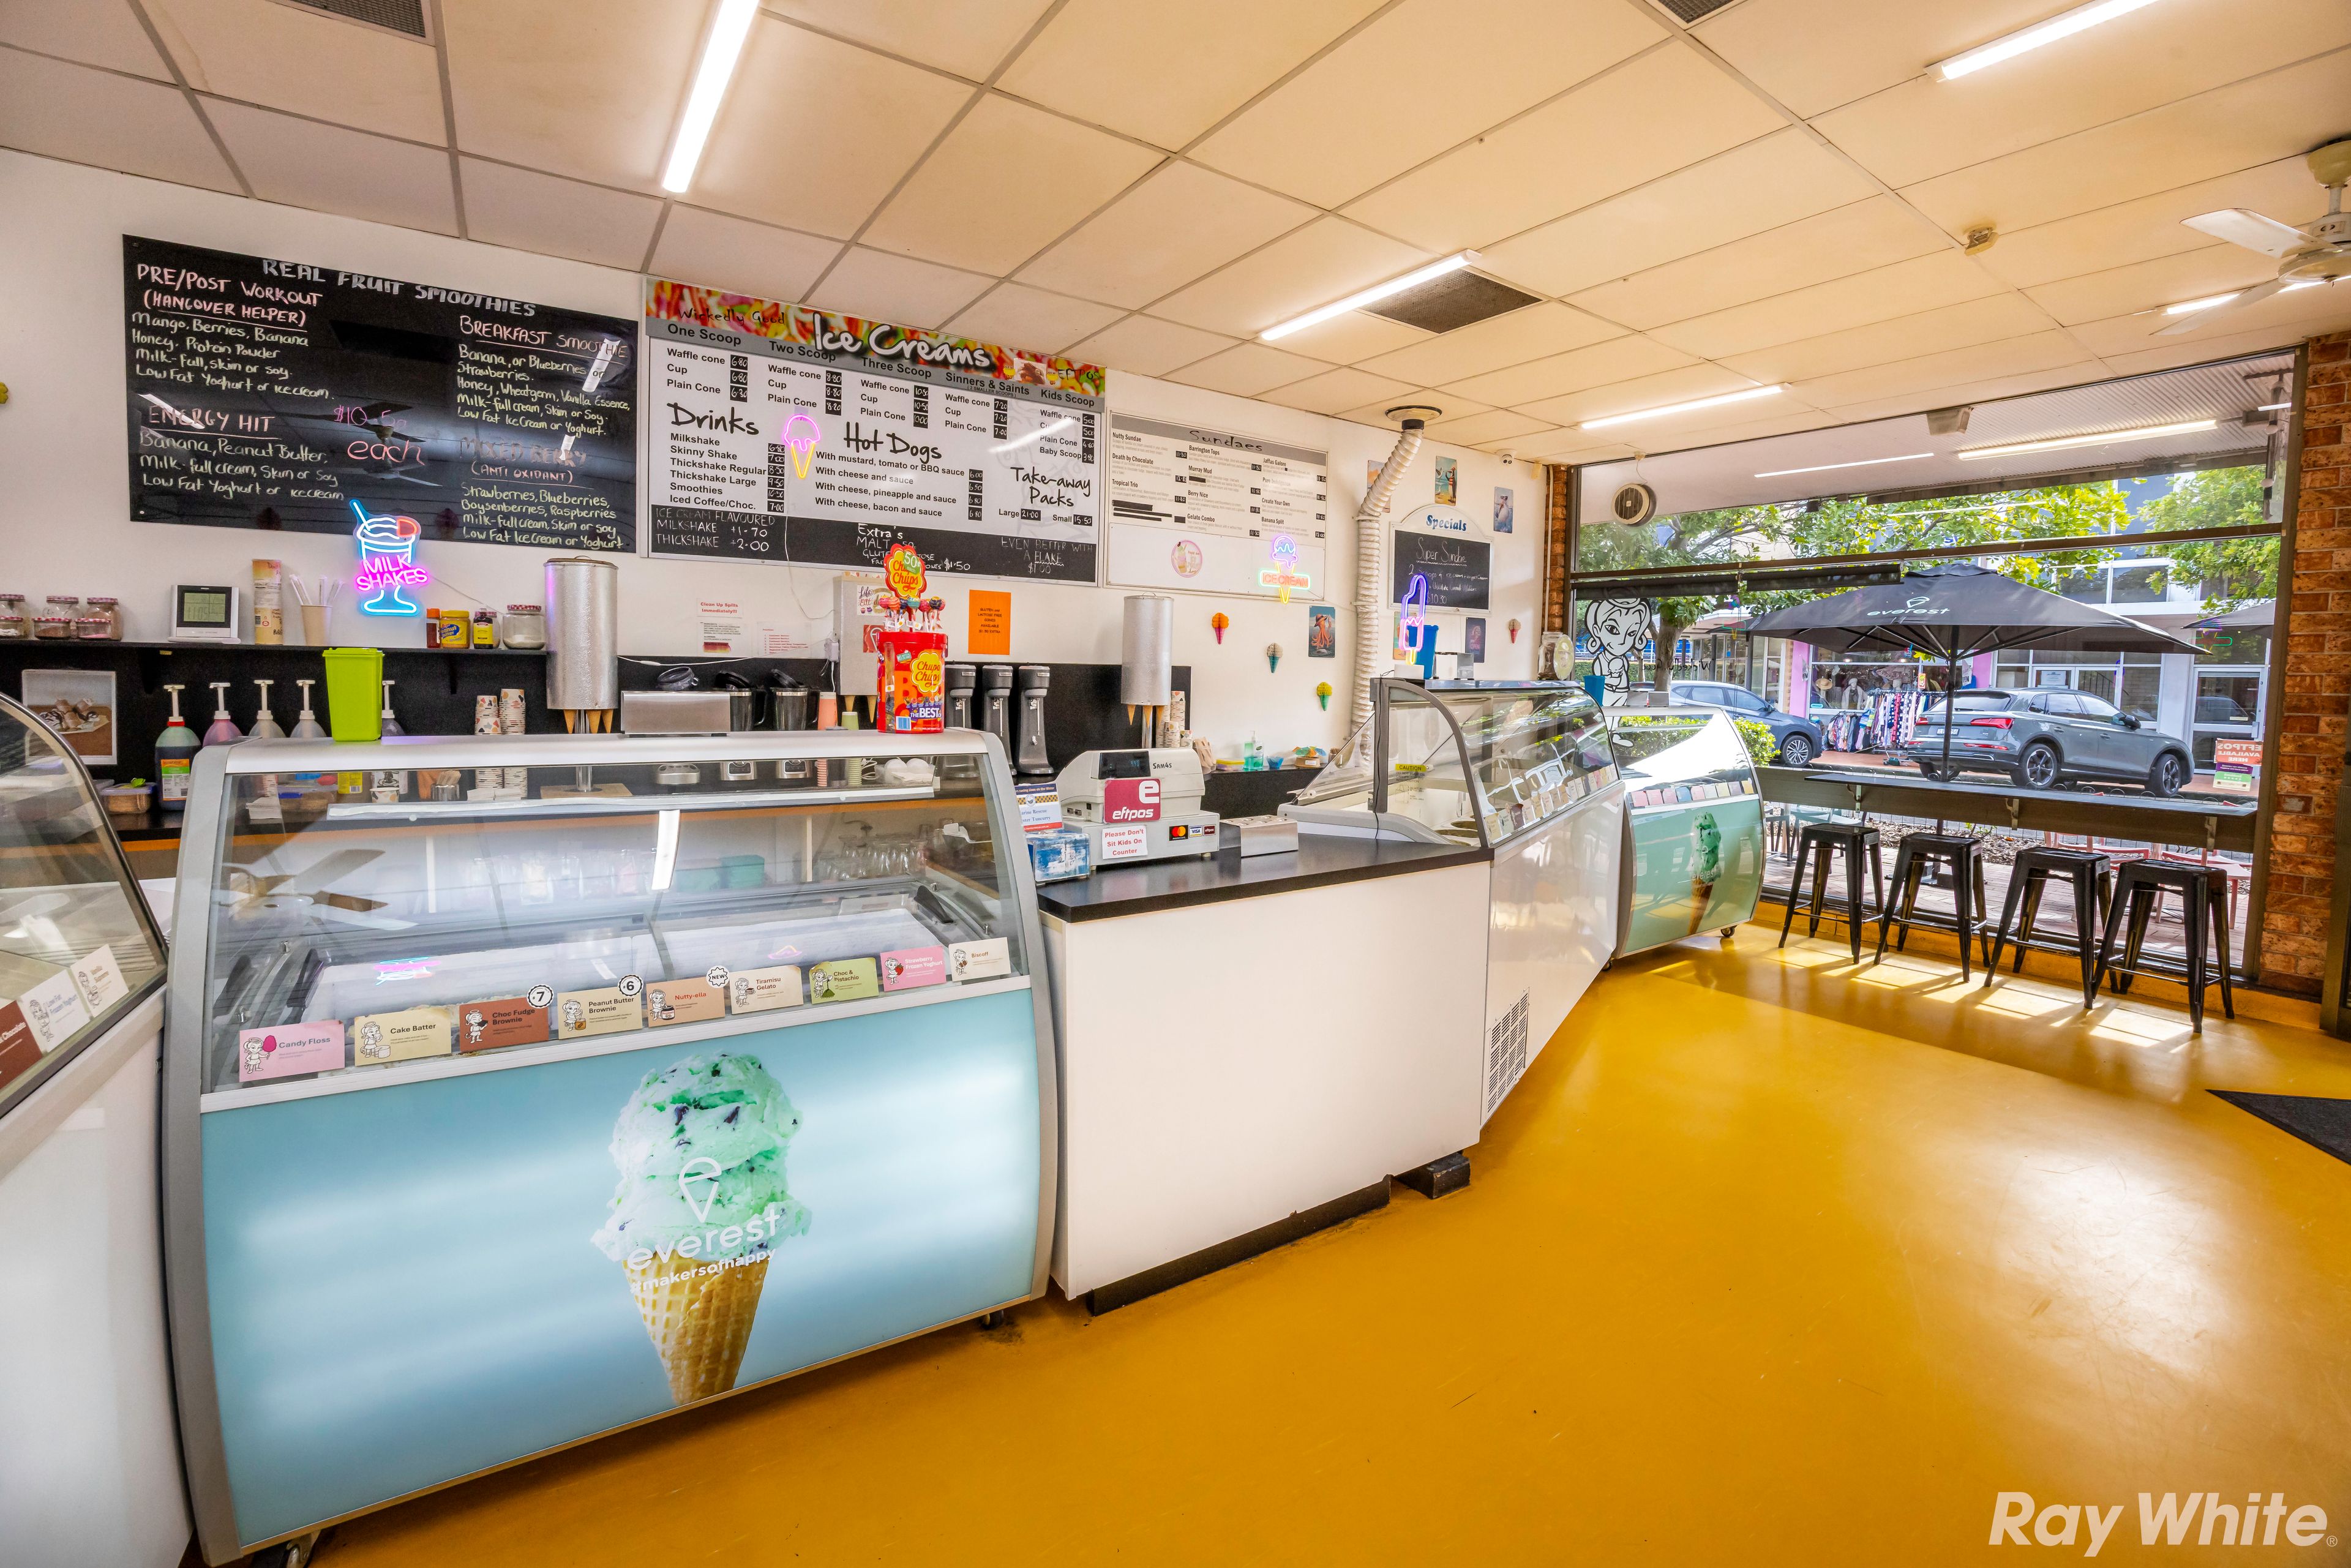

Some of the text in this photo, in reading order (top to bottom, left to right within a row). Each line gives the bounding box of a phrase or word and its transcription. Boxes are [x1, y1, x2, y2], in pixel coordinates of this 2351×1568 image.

[137, 263, 323, 306] PRE/POST WORKOUT
[263, 259, 536, 316] REAL FRUIT SMOOTHIES
[242, 305, 306, 327] HELPER)
[679, 307, 785, 326] Wickedly Good
[255, 328, 308, 347] Banana
[460, 315, 552, 345] BREAKFAST
[667, 323, 741, 347] One Scoop
[813, 312, 991, 368] Ice Creams
[236, 344, 280, 358] Powder
[769, 340, 836, 362] Two Scoop
[529, 354, 587, 375] Blueberries
[861, 357, 932, 379] Three Scoop
[945, 372, 1030, 395] Sinners & Saints
[1041, 389, 1095, 407] Kids Scoop
[149, 405, 275, 432] ENERGY HIT
[666, 402, 759, 435] Drinks
[218, 438, 273, 457] Peanut
[670, 433, 720, 446] Milkshake
[844, 422, 942, 464] Hot Dogs
[1190, 430, 1262, 451] Sundaes
[347, 440, 426, 466] each
[460, 436, 587, 467] MIXED BERRY
[670, 446, 737, 460] Skinny Shake
[670, 458, 767, 475] Thickshake Regular
[670, 470, 756, 487] Thickshake Large
[1011, 467, 1091, 497] Take-away
[670, 482, 723, 495] Smoothies
[816, 482, 956, 504] With cheese, pineapple and sauce
[1030, 486, 1074, 508] Packs
[550, 505, 617, 519] Raspberries
[670, 495, 756, 510] Iced Coffee/Choc.
[999, 509, 1019, 518] Large
[1427, 515, 1466, 531] Specials
[657, 520, 717, 533] MILKSHAKE
[656, 533, 719, 548] THICKSHAKE
[1416, 537, 1467, 563] Super Sundae
[362, 553, 412, 574] MILK
[356, 568, 428, 591] SHAKES
[893, 572, 918, 585] Chups
[1263, 572, 1308, 588] ICE CREAM
[917, 661, 940, 673] Chupa
[915, 672, 940, 683] Chups
[920, 708, 939, 718] BEST
[1112, 807, 1153, 820] eftpos
[924, 960, 942, 969] Yoghurt
[675, 991, 707, 1001] Nutty-ella
[391, 1022, 436, 1035] Cake Batter
[492, 1016, 522, 1025] Brownie
[279, 1037, 331, 1049] Candy Floss
[627, 1208, 781, 1272] everest
[630, 1247, 776, 1293] #makersofhappy
